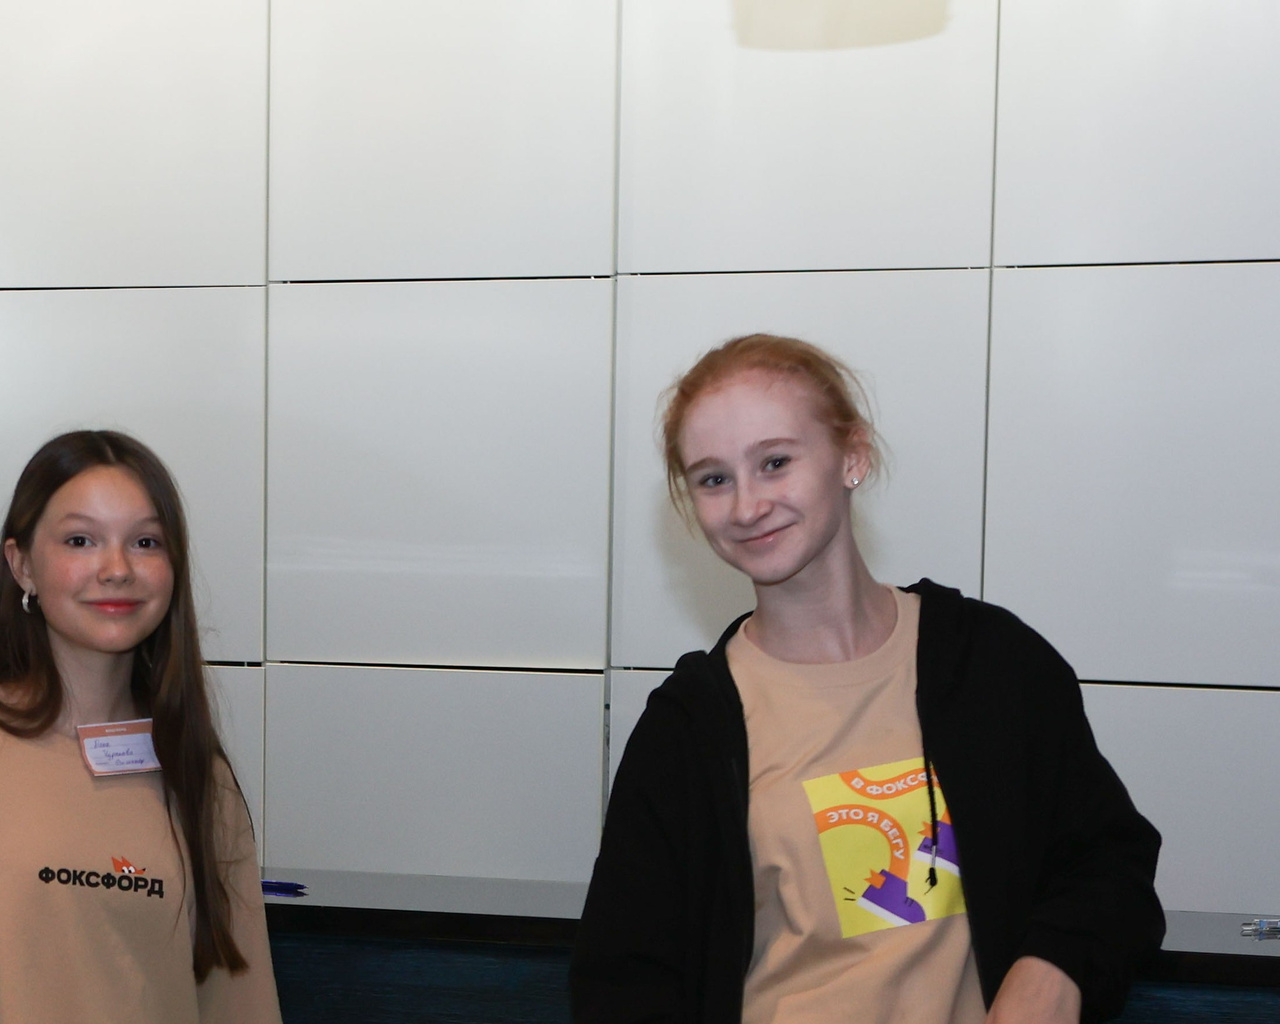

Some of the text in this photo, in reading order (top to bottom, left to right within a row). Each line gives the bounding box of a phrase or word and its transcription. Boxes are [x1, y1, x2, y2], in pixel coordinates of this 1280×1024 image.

[850, 771, 939, 795] В ФОКСФ
[826, 808, 905, 860] ЭТО Я БЕГУ
[38, 866, 164, 898] ФОКСФОРД
